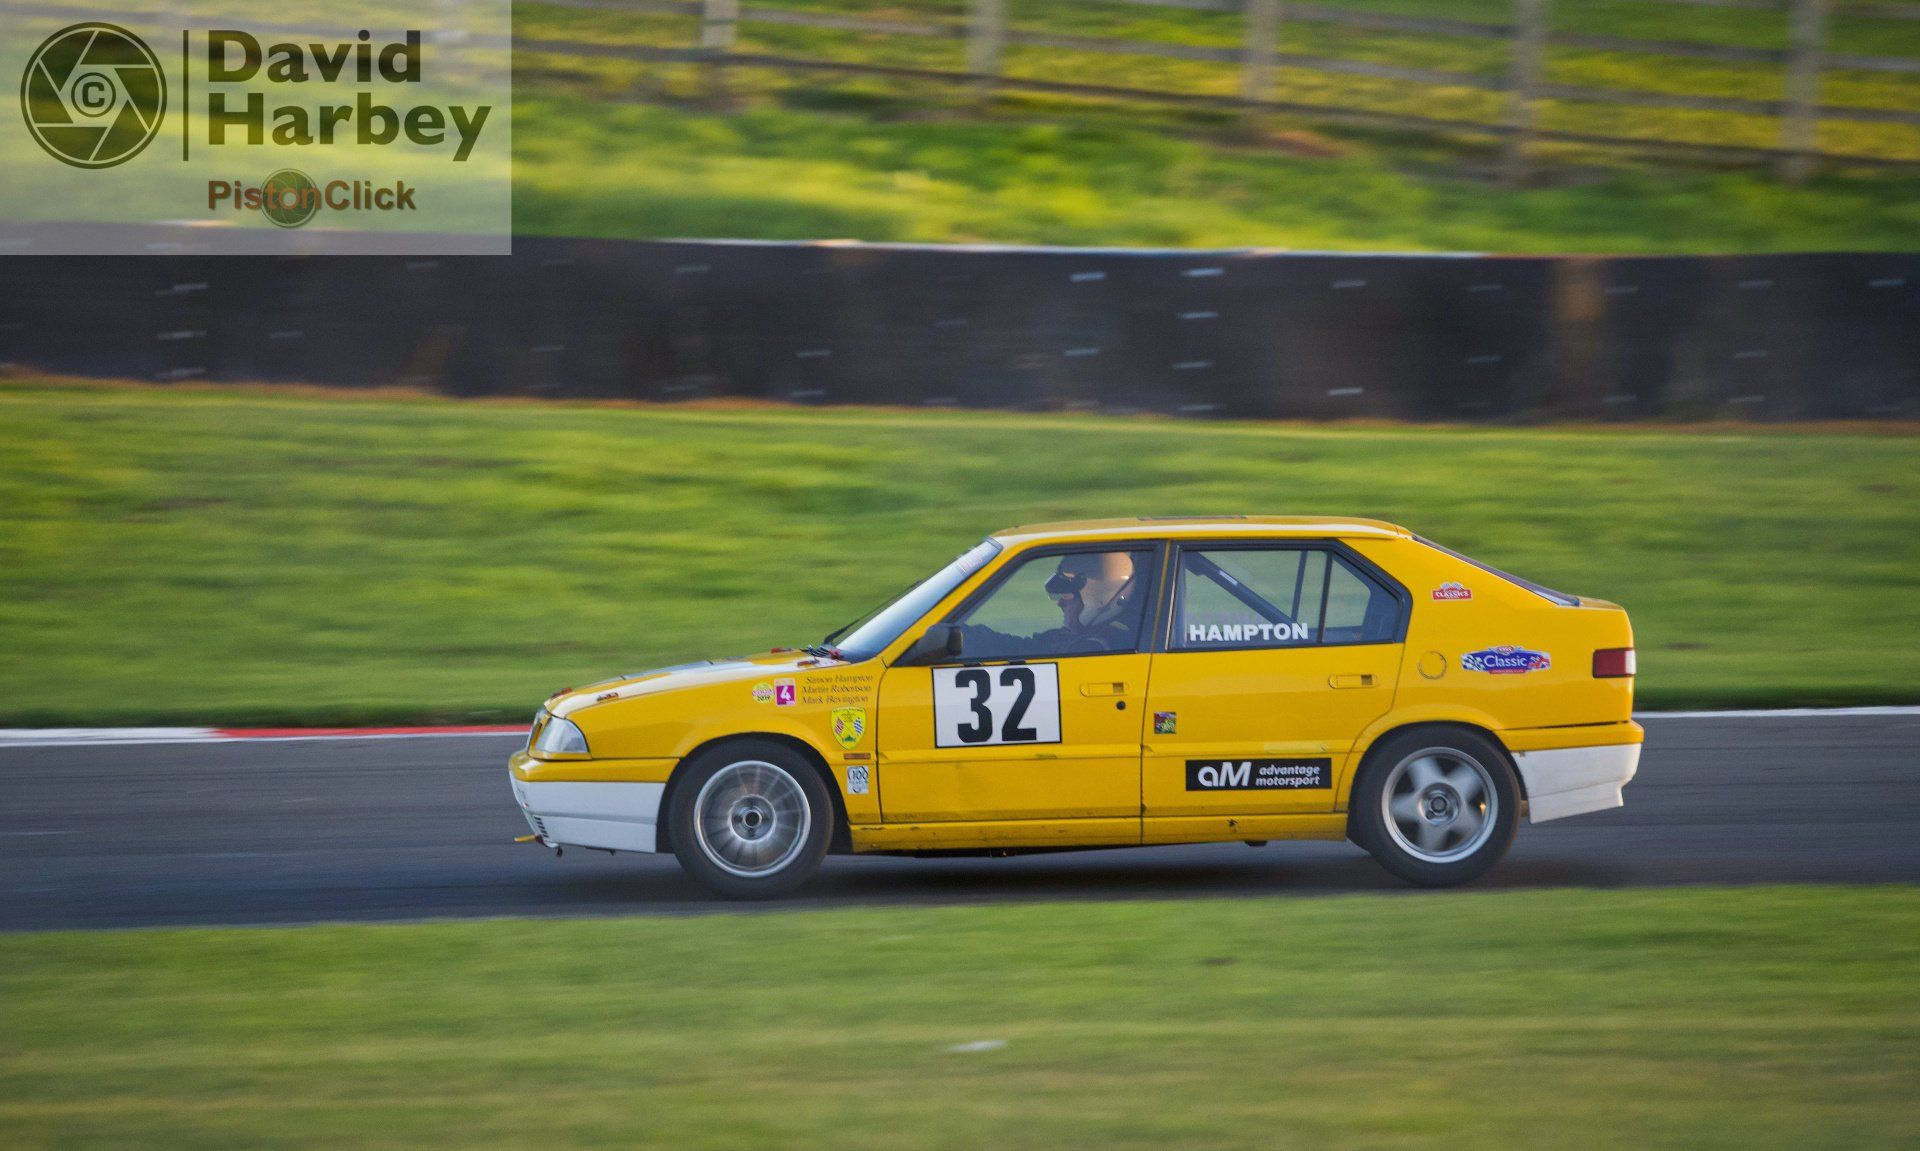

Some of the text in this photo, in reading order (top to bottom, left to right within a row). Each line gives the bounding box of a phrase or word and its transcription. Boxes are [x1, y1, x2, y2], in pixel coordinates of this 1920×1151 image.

[1189, 622, 1308, 641] HAMPTON
[1484, 655, 1528, 668] Classic
[835, 674, 873, 684] Hampton
[780, 684, 791, 700] 4
[802, 696, 823, 705] Mark
[955, 667, 1037, 743] 32
[1259, 764, 1320, 776] advantage
[1255, 776, 1321, 788] motorsport
